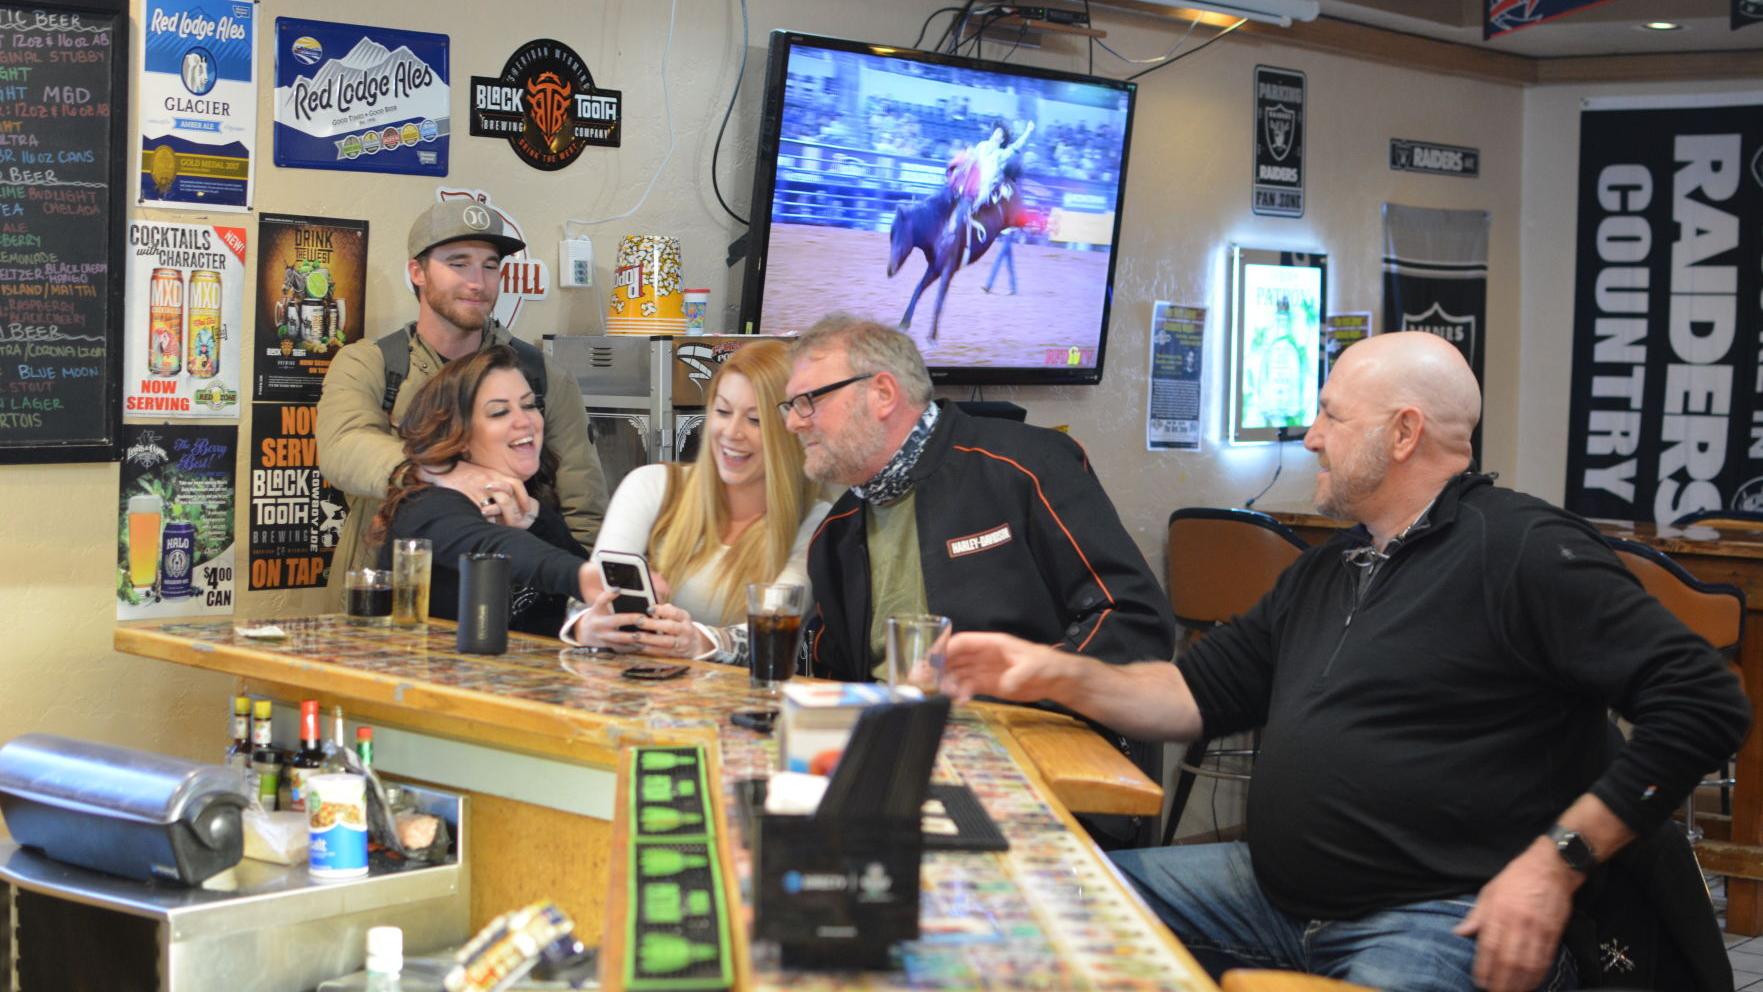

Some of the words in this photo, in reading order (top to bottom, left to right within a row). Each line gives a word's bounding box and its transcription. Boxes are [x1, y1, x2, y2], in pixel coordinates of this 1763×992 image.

[35, 12, 81, 27] BEER
[151, 8, 178, 36] Red
[179, 11, 215, 41] Lodge
[216, 16, 246, 43] Ales
[49, 50, 105, 63] STUBBY
[43, 86, 91, 105] MGD
[294, 78, 333, 121] Red
[337, 70, 390, 114] Lodge
[394, 60, 433, 99] Ales
[1258, 81, 1303, 104] PARKING
[164, 97, 231, 117] GLACIER
[476, 84, 526, 113] BLACK
[574, 93, 618, 121] TOOTH
[482, 119, 524, 133] BREWING
[574, 126, 610, 140] COMPANY
[57, 150, 95, 164] CANS
[180, 158, 201, 168] GOLD
[1412, 147, 1464, 171] RAIDERS
[9, 167, 59, 183] BEER
[1259, 165, 1299, 182] RAIDERS
[1256, 191, 1276, 208] FAN
[1278, 192, 1302, 209] ZONE
[130, 224, 212, 251] COCKTAILS
[224, 229, 246, 255] NEW!
[294, 228, 334, 249] DRINK
[136, 243, 162, 257] with
[158, 250, 227, 271] CHARACTER
[151, 279, 183, 308] MXD
[189, 282, 222, 310] MXD
[8, 323, 62, 339] BEER
[1583, 164, 1654, 502] COUNTRY
[1655, 133, 1742, 525] RAIDERS
[18, 364, 57, 380] BLUE
[62, 367, 99, 379] MOON
[141, 379, 177, 394] NOW
[11, 396, 64, 410] LAGER
[126, 396, 190, 411] SERVING
[253, 469, 310, 497] BLACK
[253, 498, 310, 525] TOOTH
[253, 530, 309, 544] BREWING
[252, 559, 281, 588] ON
[286, 557, 325, 588] TAP
[206, 590, 232, 607] CAN
